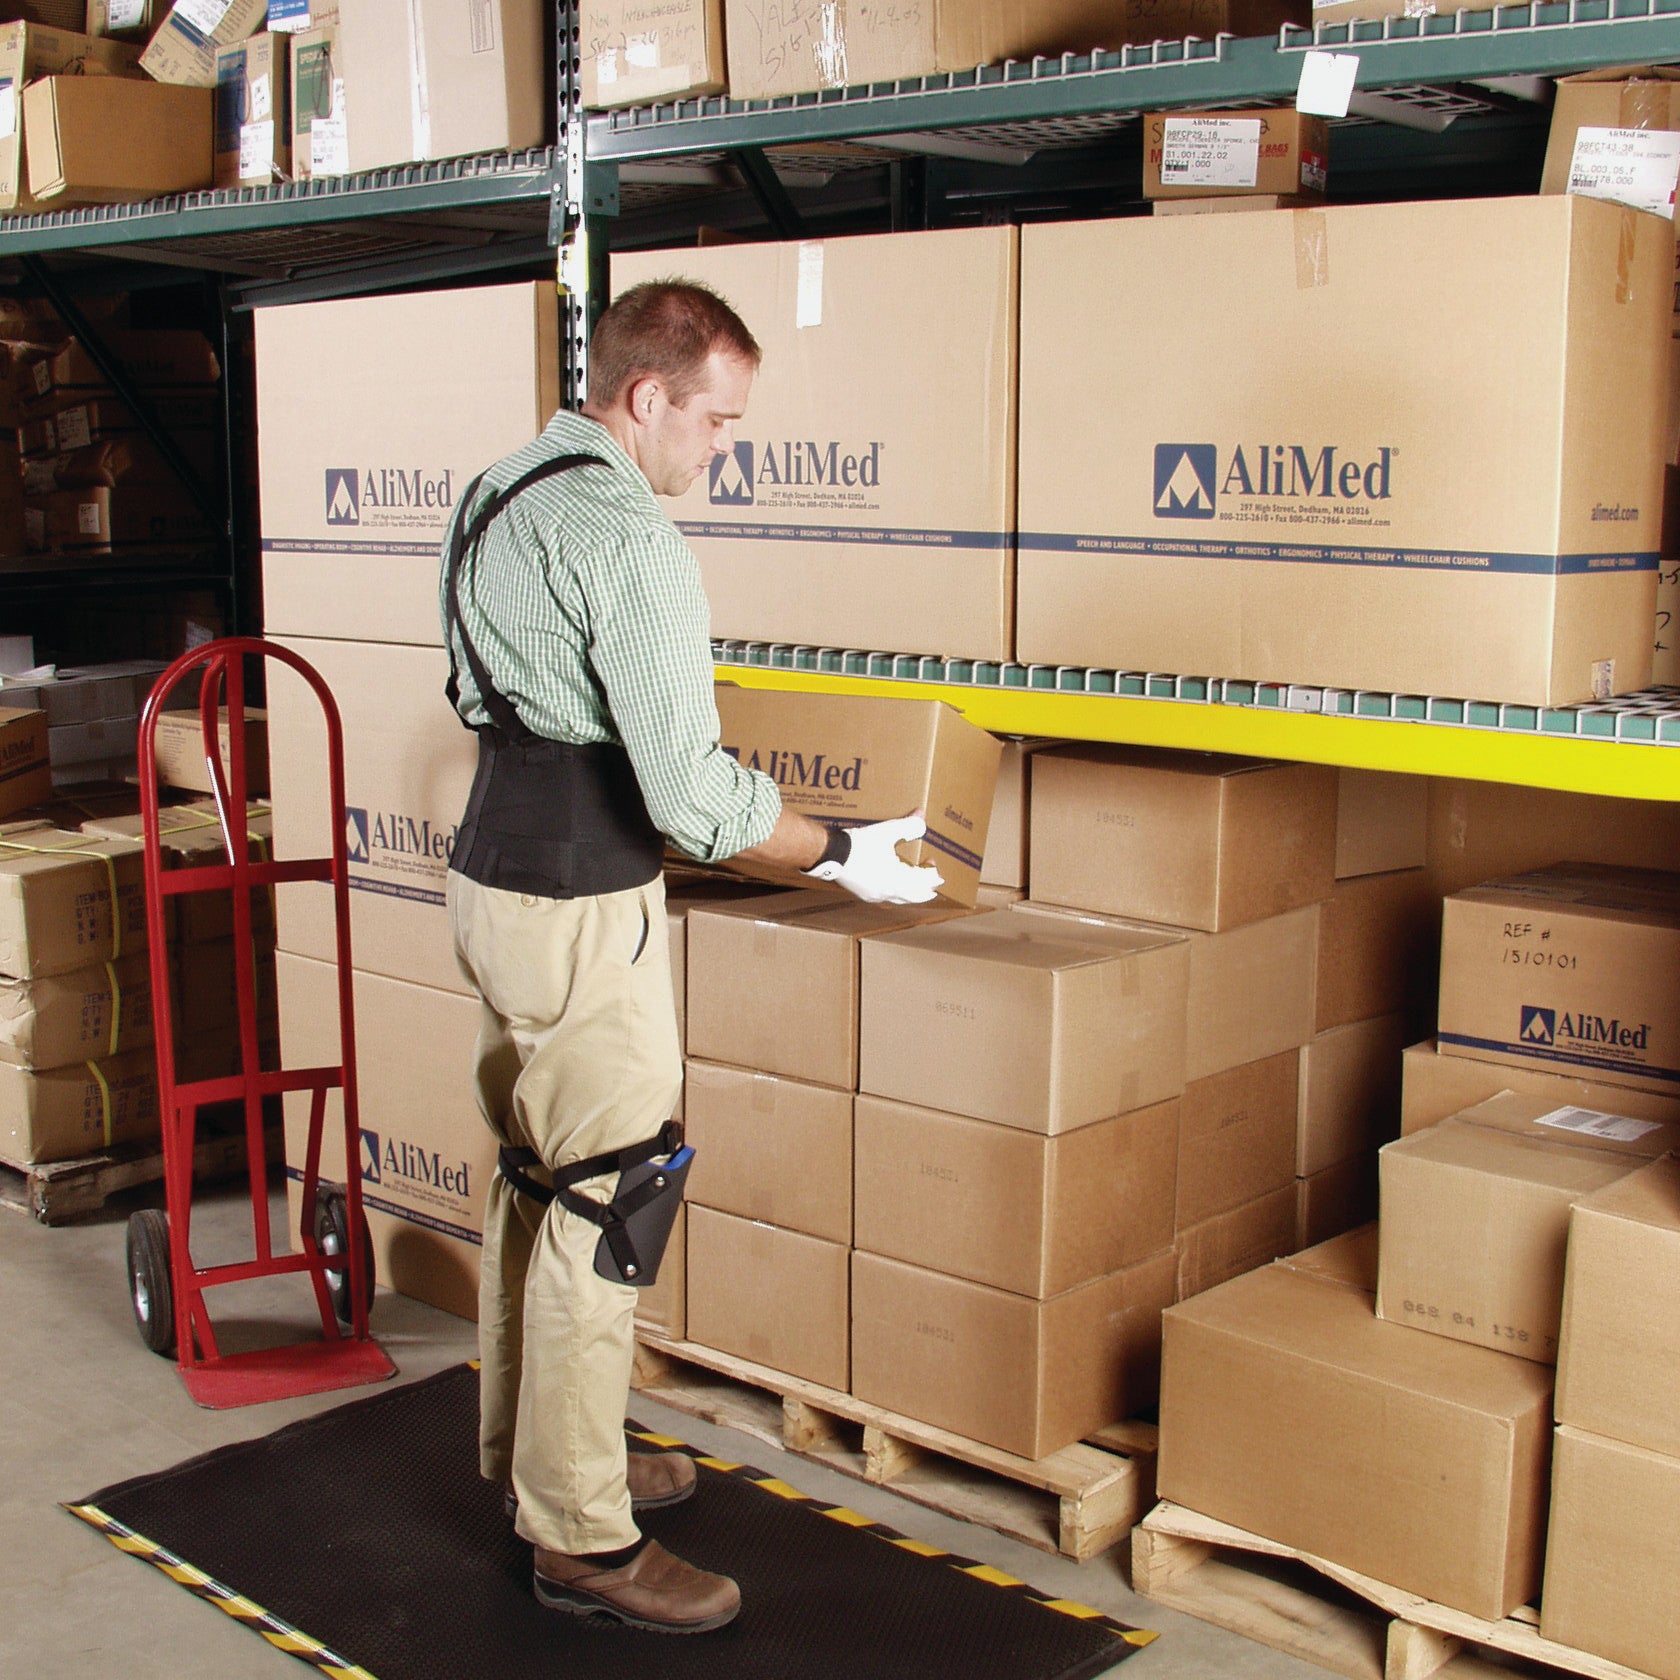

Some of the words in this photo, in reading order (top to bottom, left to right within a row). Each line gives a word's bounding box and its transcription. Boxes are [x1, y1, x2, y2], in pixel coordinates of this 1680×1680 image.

[1239, 503, 1253, 512] 297
[1255, 503, 1271, 514] High
[1272, 504, 1297, 514] Street,
[1299, 505, 1331, 515] Dedham,
[1333, 506, 1345, 515] MA
[1591, 503, 1639, 521] alimed.com
[1275, 514, 1287, 523] Fax
[1347, 516, 1391, 527] alimed.com
[1404, 554, 1451, 564] WHEELCHAIR
[1452, 556, 1490, 567] CUSHIONS
[1503, 922, 1532, 938] REF
[1503, 949, 1577, 970] 1510101
